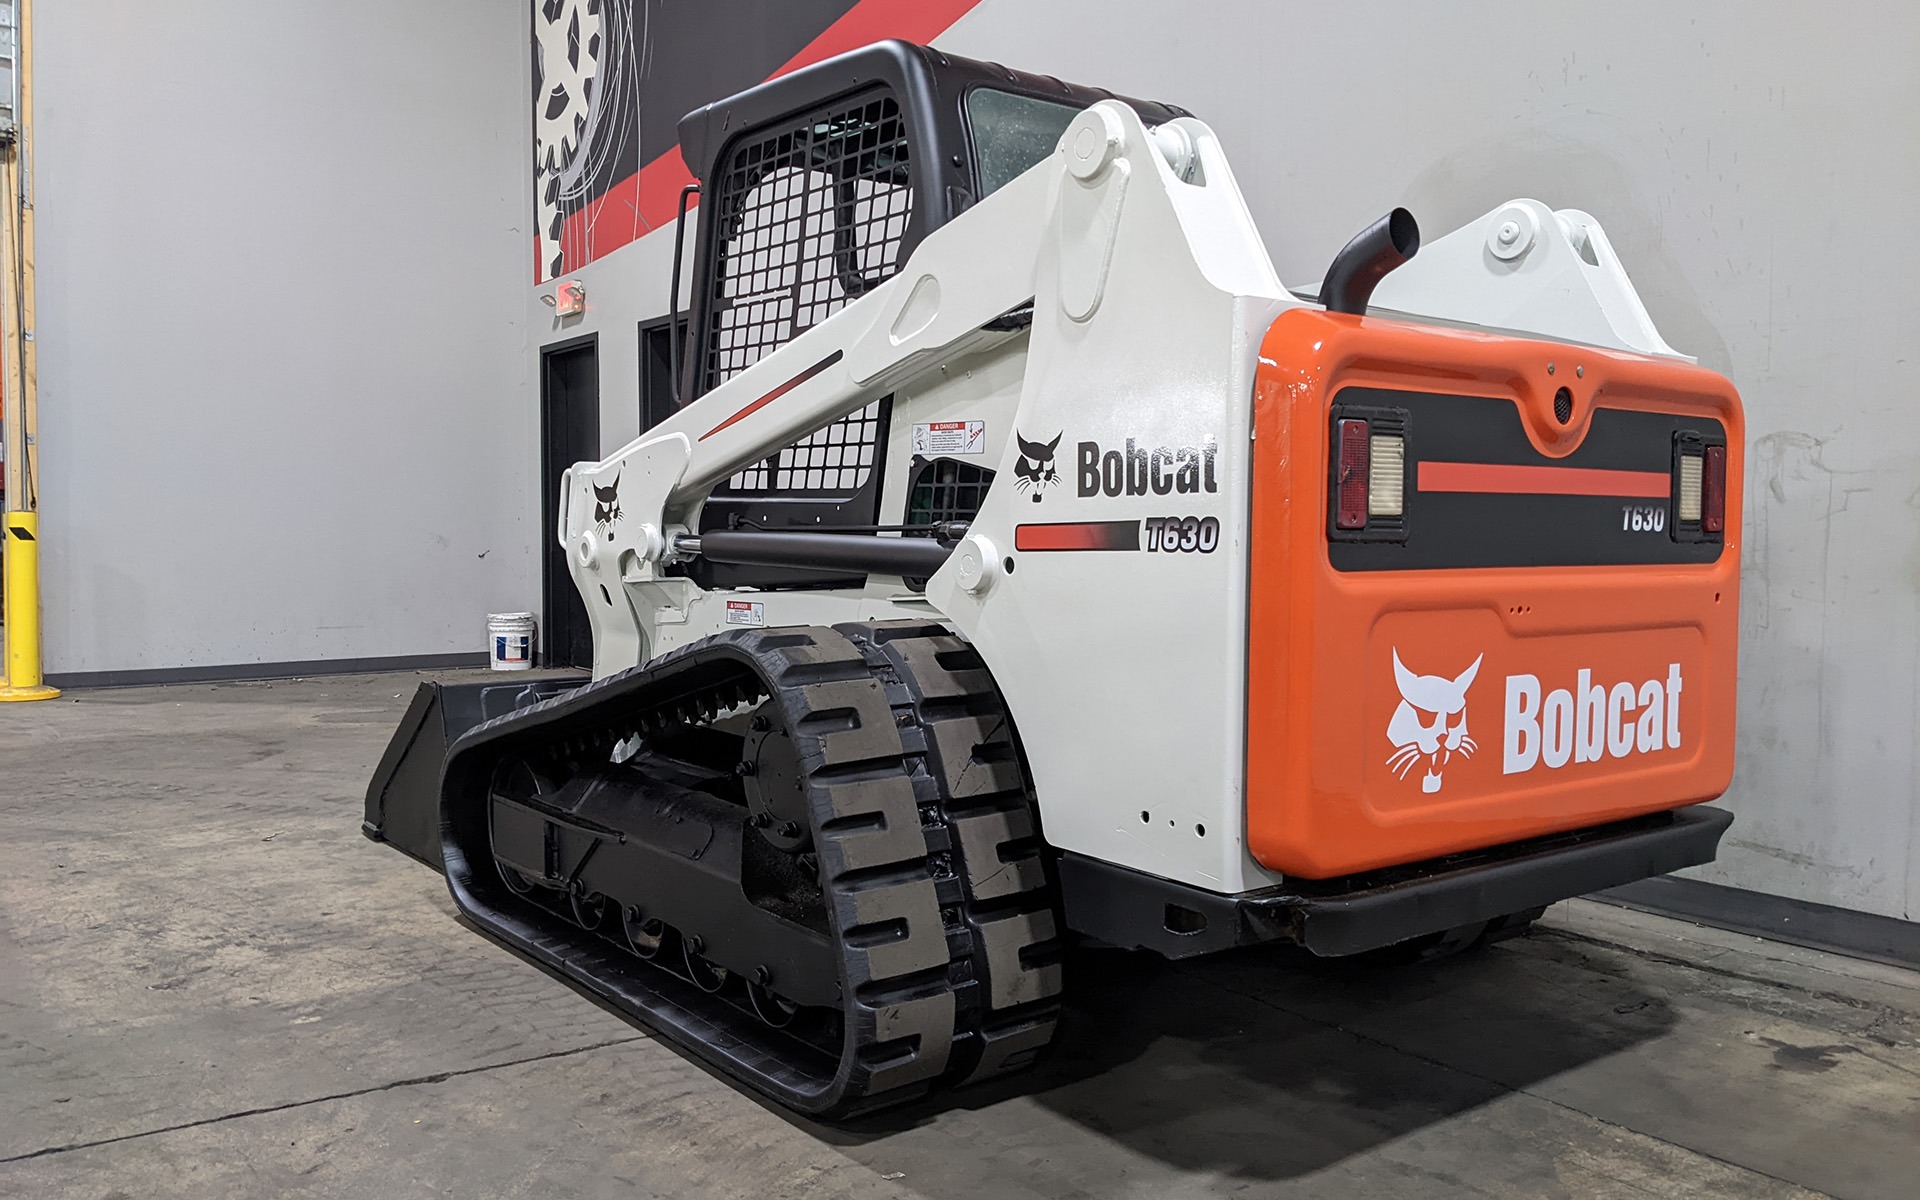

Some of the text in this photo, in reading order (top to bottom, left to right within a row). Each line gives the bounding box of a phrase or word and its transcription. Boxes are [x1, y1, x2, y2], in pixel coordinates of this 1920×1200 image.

[1077, 433, 1218, 498] Bobcat
[1145, 516, 1220, 553] T630
[1622, 505, 1665, 532] T630
[1503, 663, 1683, 775] Bobcat
